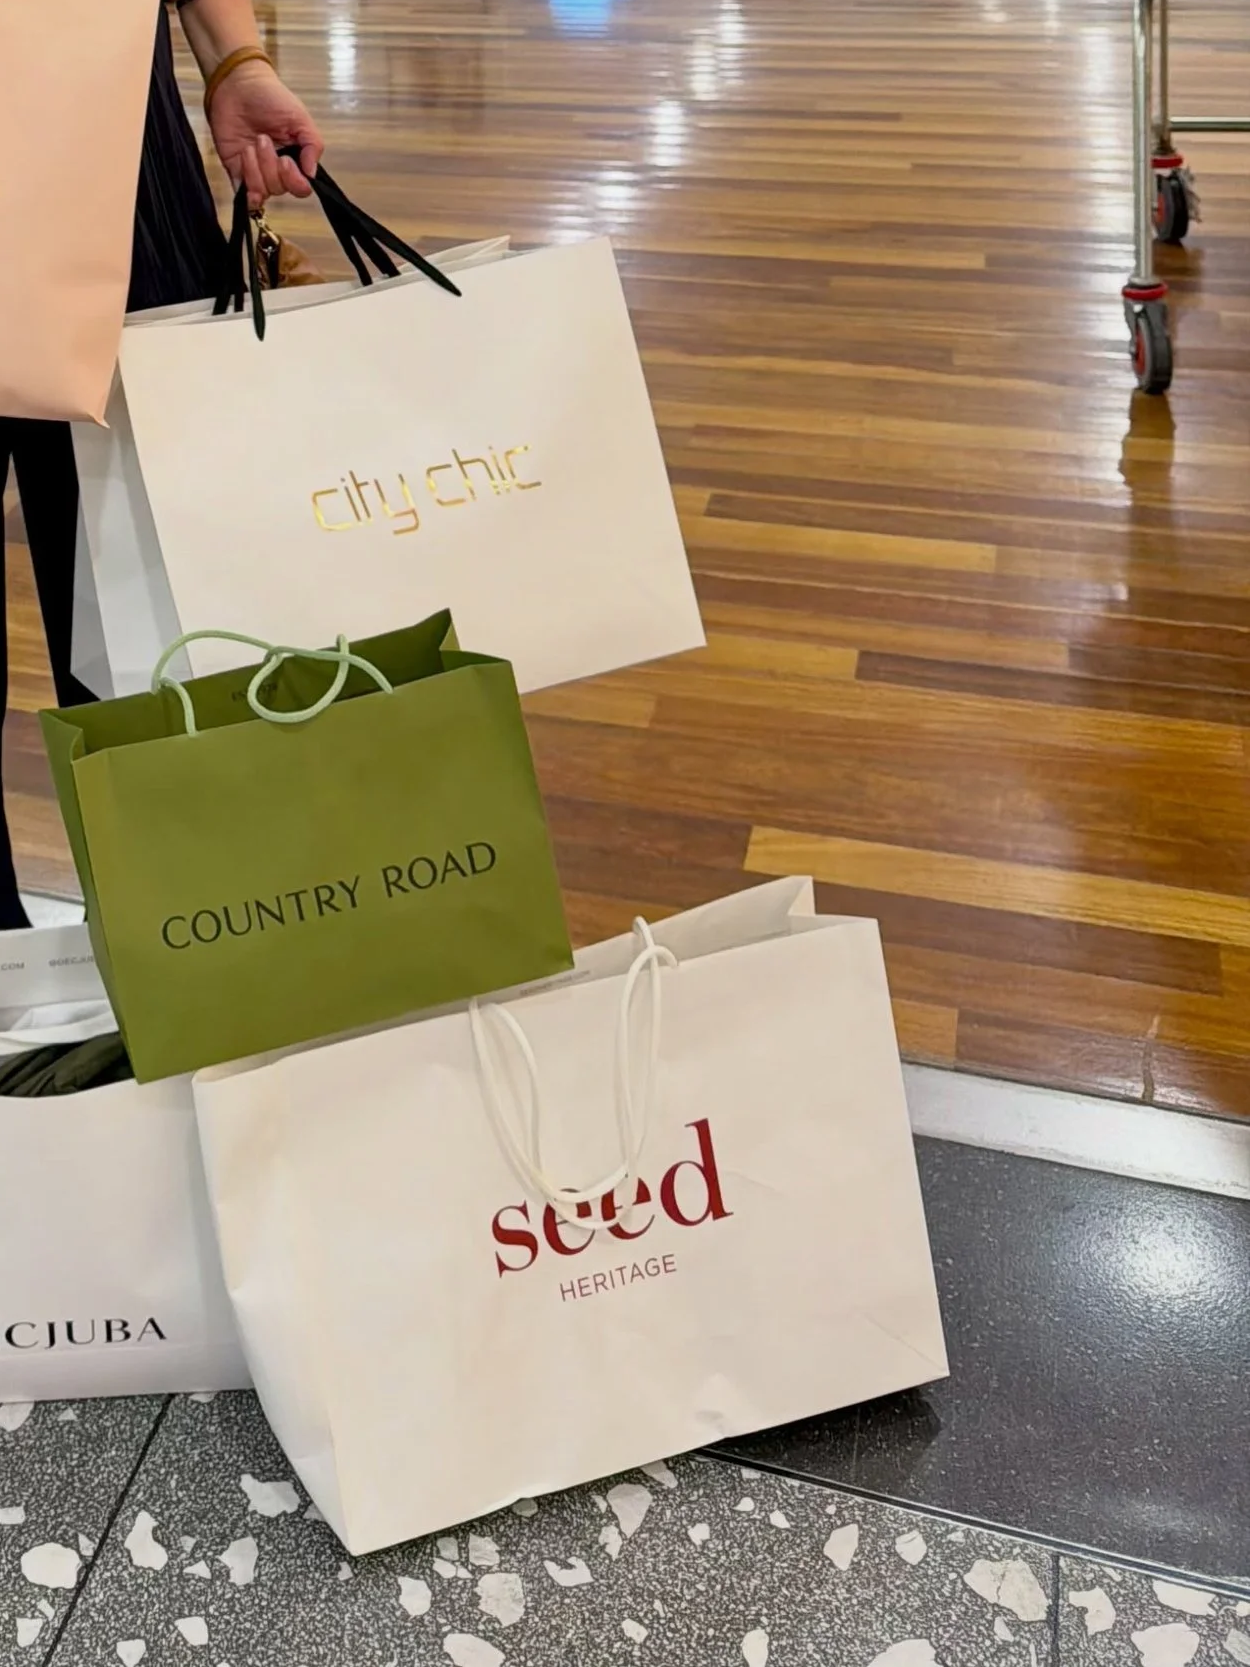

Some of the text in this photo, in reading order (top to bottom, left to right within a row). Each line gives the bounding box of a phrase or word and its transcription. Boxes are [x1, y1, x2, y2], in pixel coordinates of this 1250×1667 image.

[311, 444, 543, 536] city chic
[161, 841, 497, 950] COUNTRY ROAD
[491, 1118, 735, 1279] seed
[560, 1253, 678, 1303] HERITAGE
